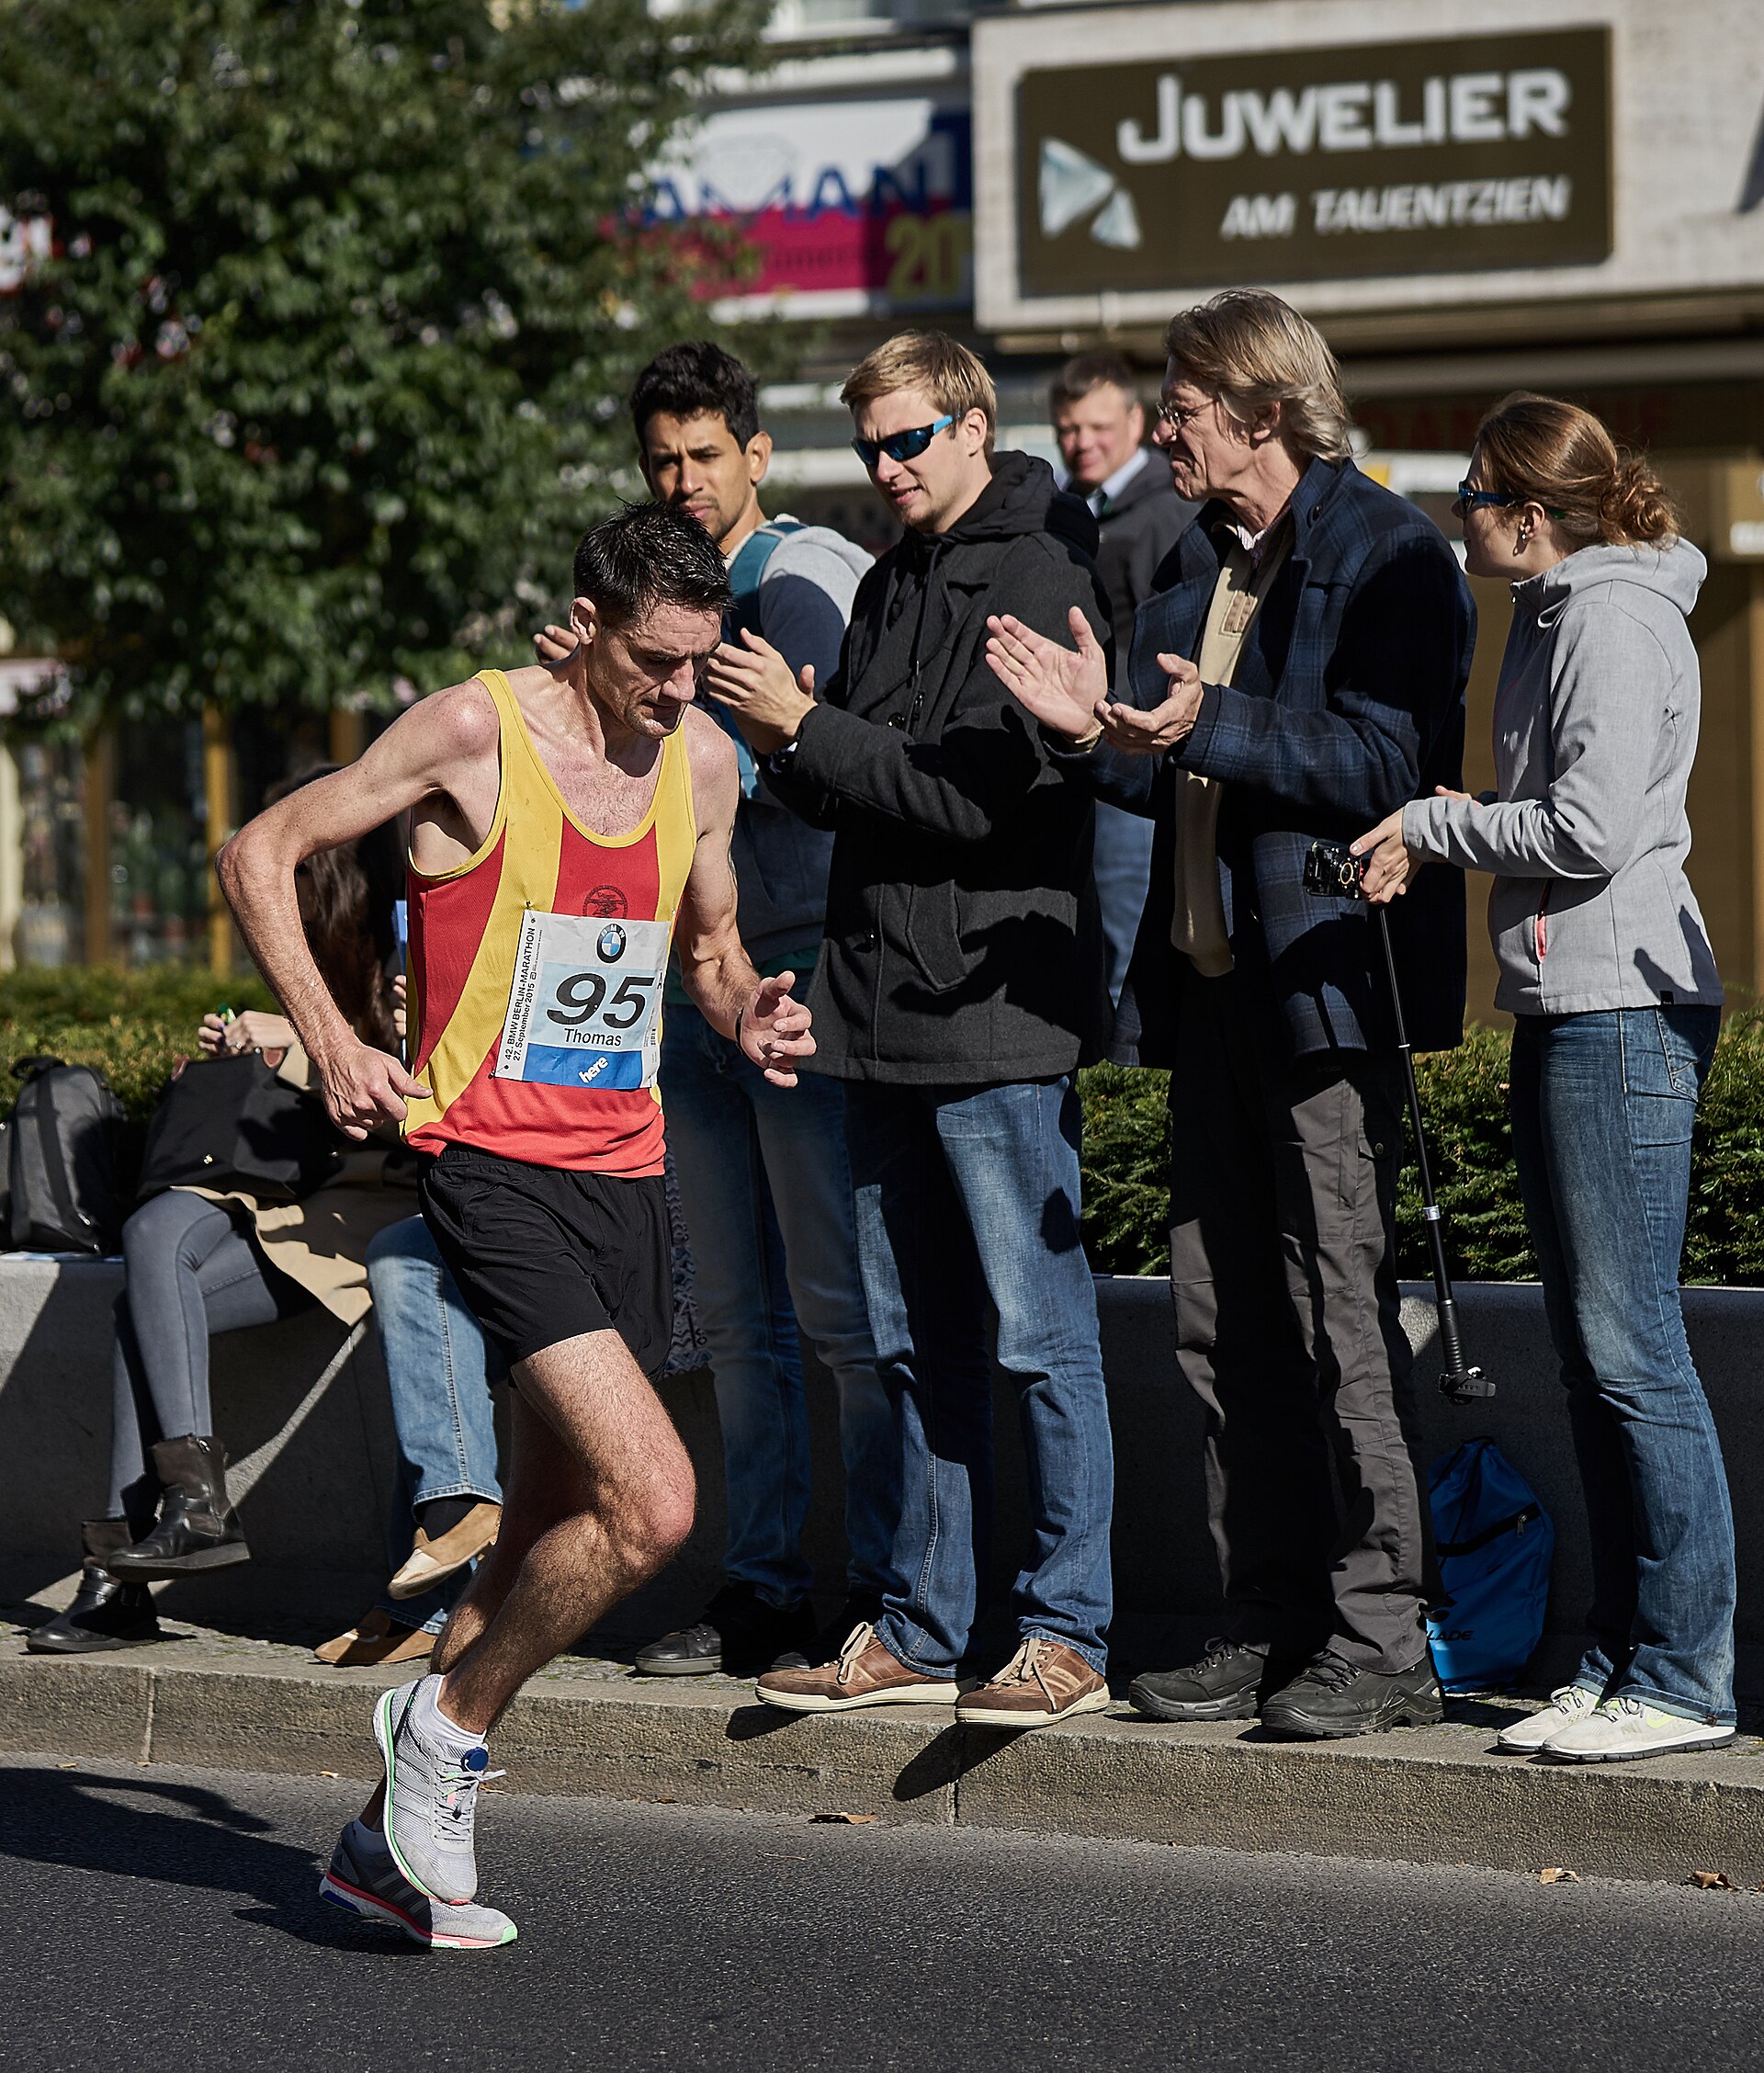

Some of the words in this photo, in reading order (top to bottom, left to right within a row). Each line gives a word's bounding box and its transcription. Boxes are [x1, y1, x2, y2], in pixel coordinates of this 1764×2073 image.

[1117, 68, 1570, 166] JUWELIER
[1221, 194, 1295, 241] AM
[1312, 174, 1571, 235] TAUENTZIEN
[601, 923, 626, 939] BMW
[512, 927, 536, 1021] BERLIN-MARATHON
[525, 982, 535, 1003] 2015
[547, 972, 655, 1029] 95
[506, 1020, 518, 1045] BMW
[514, 1003, 531, 1048] September
[563, 1027, 622, 1048] Thomas
[504, 1046, 514, 1060] 42.
[513, 1049, 522, 1061] 27.
[578, 1056, 609, 1084] here
[1426, 1629, 1475, 1641] LADE
